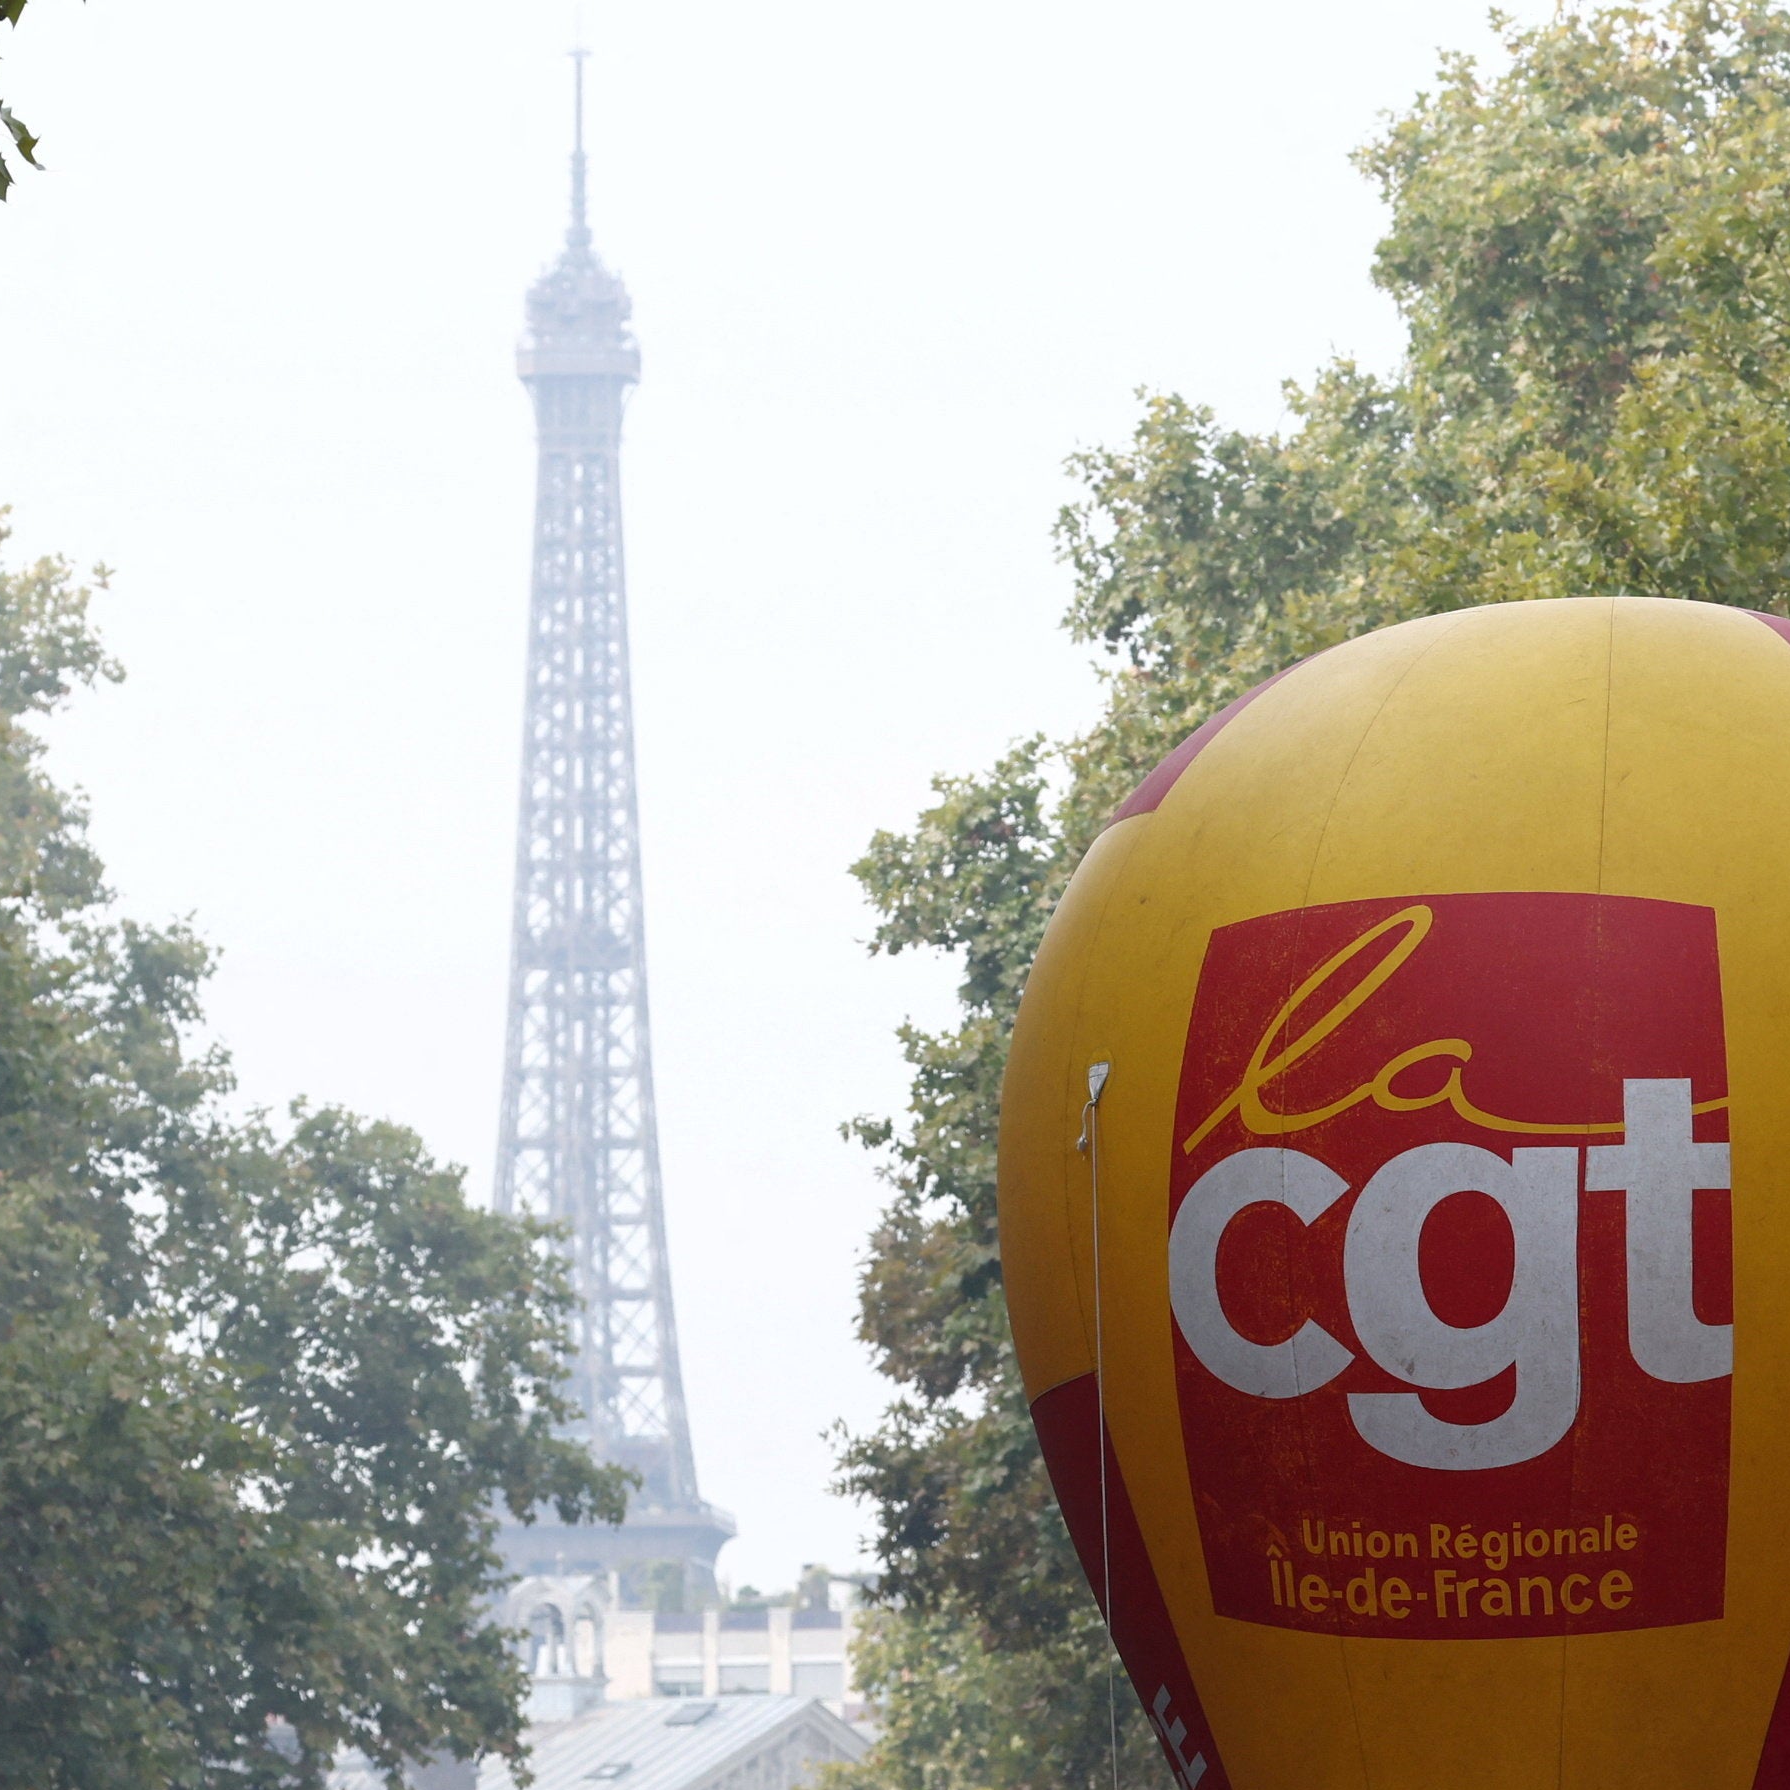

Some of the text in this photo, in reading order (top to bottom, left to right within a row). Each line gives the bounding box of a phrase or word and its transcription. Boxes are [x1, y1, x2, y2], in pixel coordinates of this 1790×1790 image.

[1183, 905, 1630, 1155] la
[1168, 1078, 1733, 1471] cgt
[1268, 1543, 1634, 1619] Île-de-France
[1302, 1515, 1639, 1571] Union Régionale
